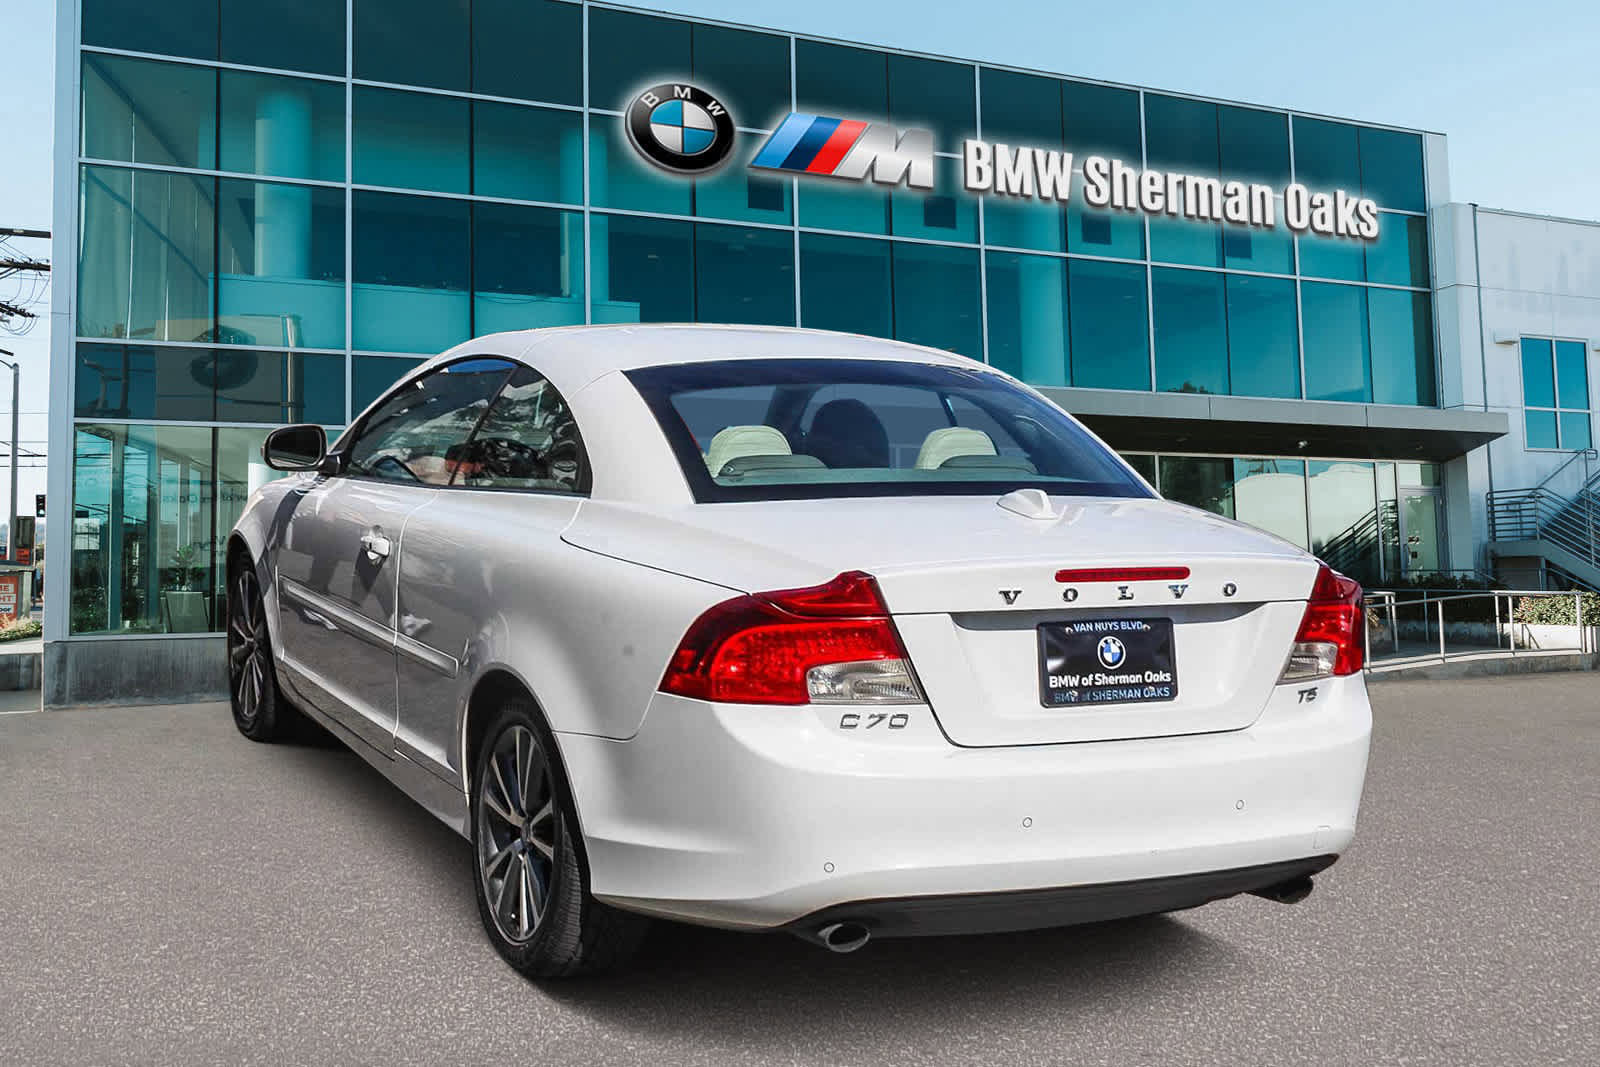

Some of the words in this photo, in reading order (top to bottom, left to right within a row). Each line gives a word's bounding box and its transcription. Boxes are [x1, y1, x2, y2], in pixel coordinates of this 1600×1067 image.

[640, 84, 725, 118] BMW
[963, 139, 1073, 200] BMW
[1083, 155, 1275, 227] Sherman
[1283, 182, 1380, 242] Oaks
[998, 584, 1238, 605] VOLVO
[1073, 623, 1094, 633] VAN
[1095, 621, 1119, 632] NUYS
[1121, 620, 1144, 630] BLVD
[1049, 675, 1080, 688] BMW
[1081, 674, 1094, 686] of
[1095, 672, 1142, 686] Sherman
[1145, 671, 1172, 682] Oaks
[1092, 689, 1141, 702] SHERMAN
[1143, 687, 1170, 698] OAKS
[1298, 687, 1318, 704] T5
[840, 713, 909, 729] C70
